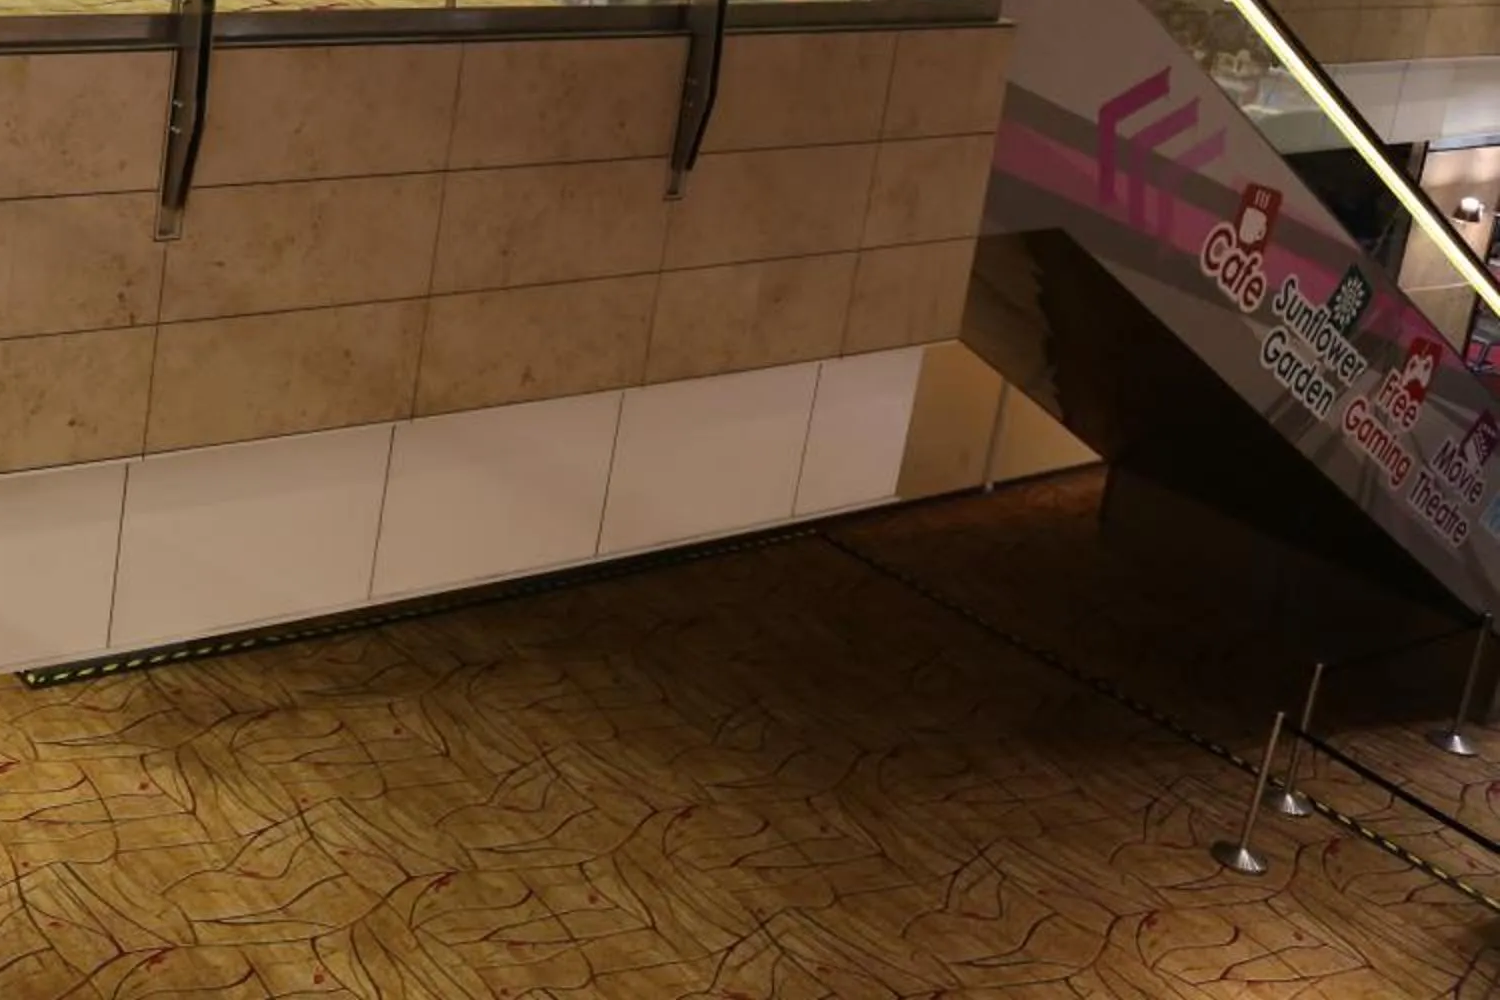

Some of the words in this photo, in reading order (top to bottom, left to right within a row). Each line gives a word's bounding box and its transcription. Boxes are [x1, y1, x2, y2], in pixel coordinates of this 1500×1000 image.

[1203, 226, 1266, 309] Cafe
[1274, 276, 1365, 383] Sunflower
[1262, 329, 1334, 416] Garden
[1378, 371, 1418, 428] Free
[1344, 399, 1412, 487] Gaming
[1431, 439, 1484, 504] Movie
[1409, 470, 1468, 543] Theatre
